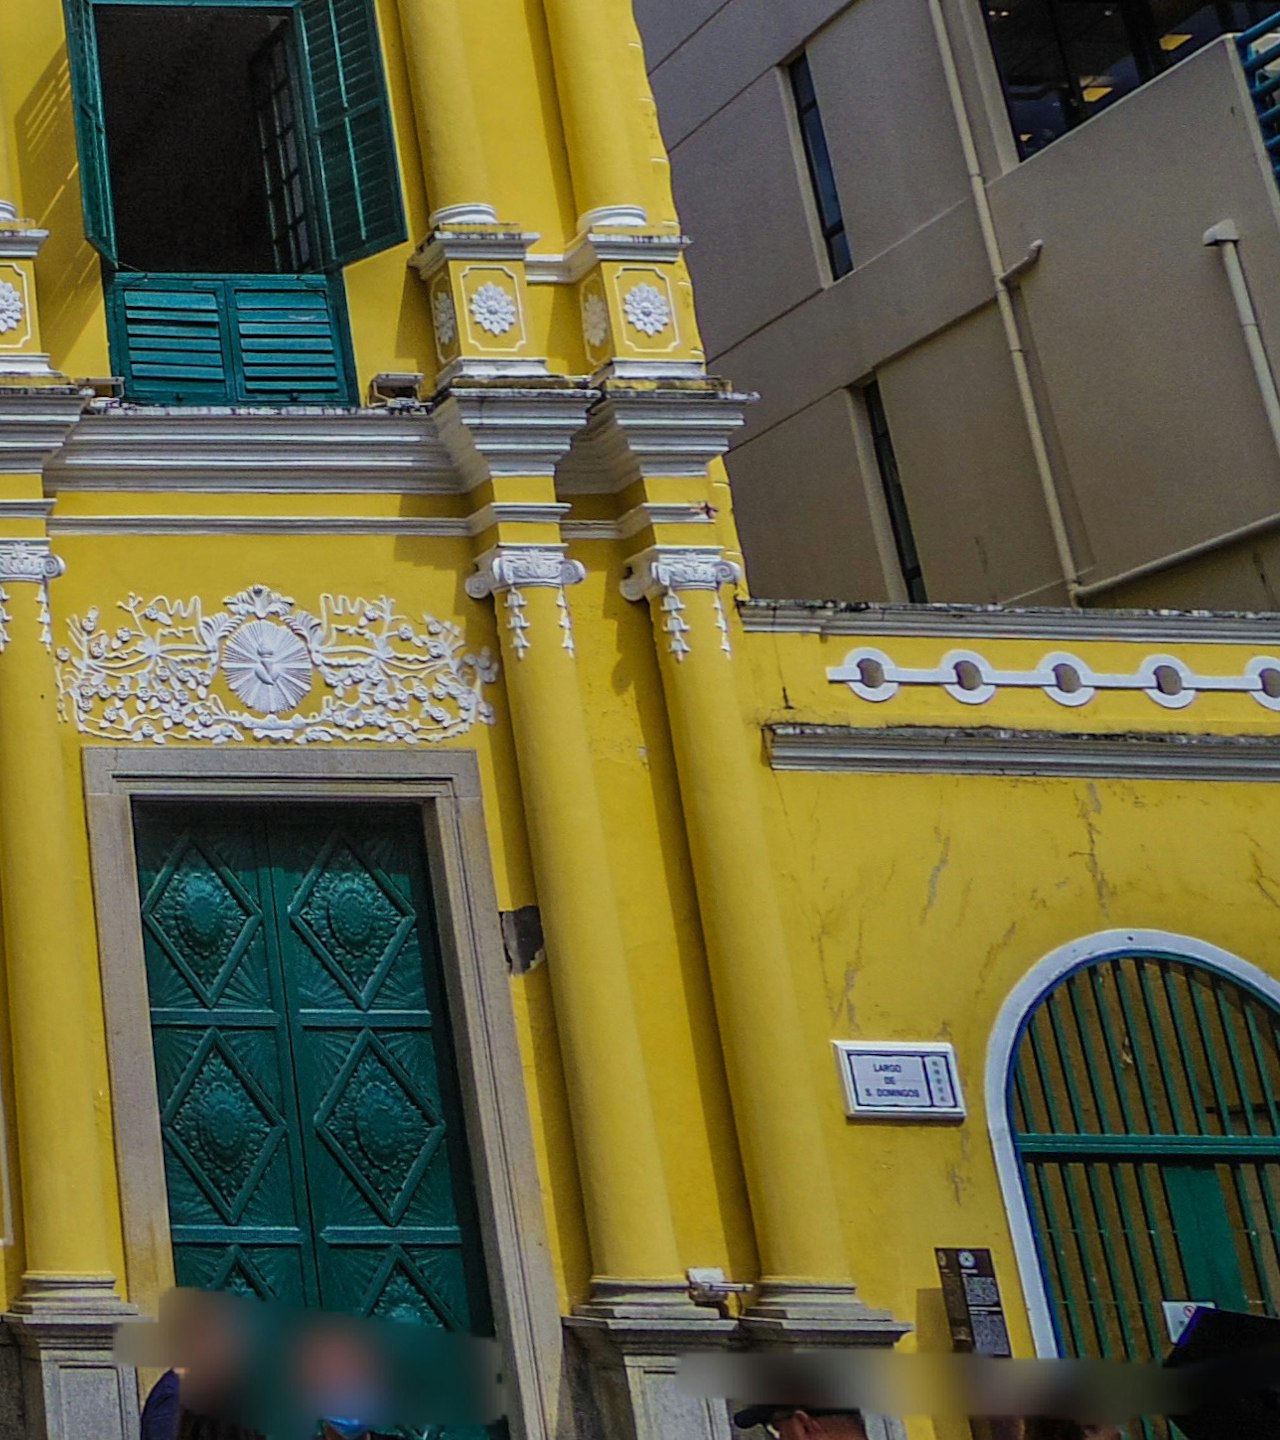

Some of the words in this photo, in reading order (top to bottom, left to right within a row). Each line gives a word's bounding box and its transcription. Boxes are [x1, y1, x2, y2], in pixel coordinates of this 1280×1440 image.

[873, 1064, 902, 1073] LARGO
[884, 1076, 896, 1085] DE
[876, 1088, 920, 1098] DOMINGOS
